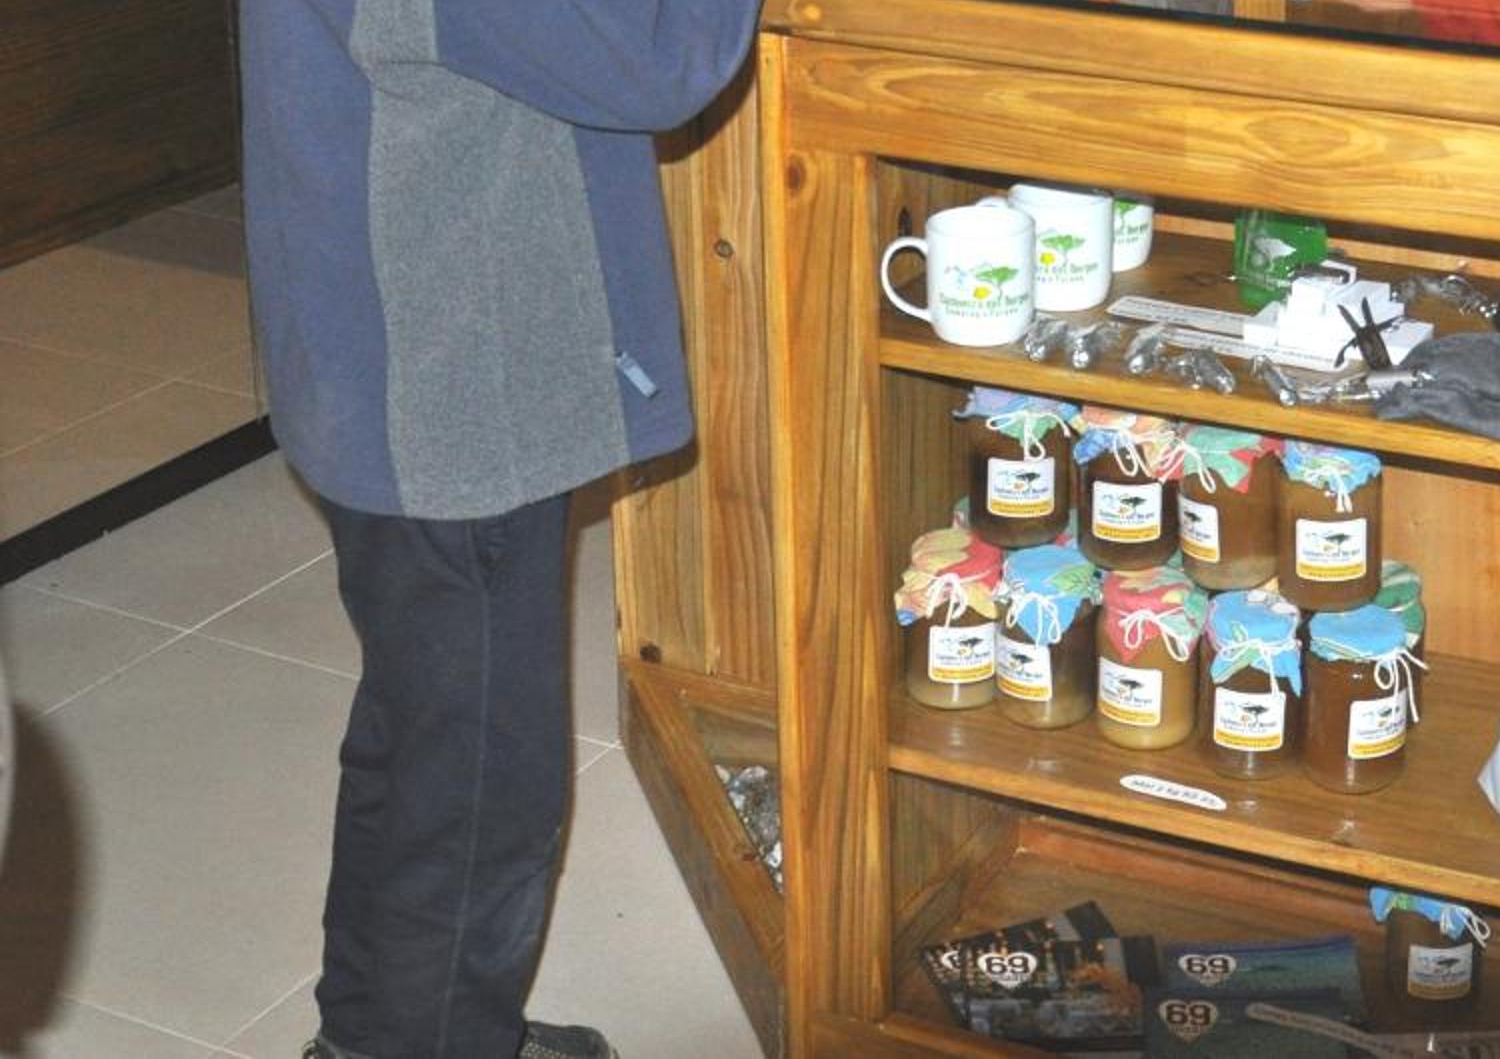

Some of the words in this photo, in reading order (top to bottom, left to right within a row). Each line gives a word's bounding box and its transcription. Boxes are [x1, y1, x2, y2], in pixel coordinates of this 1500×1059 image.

[985, 956, 1031, 974] 69
[1186, 956, 1231, 974] 69
[1165, 1003, 1212, 1026] 69
